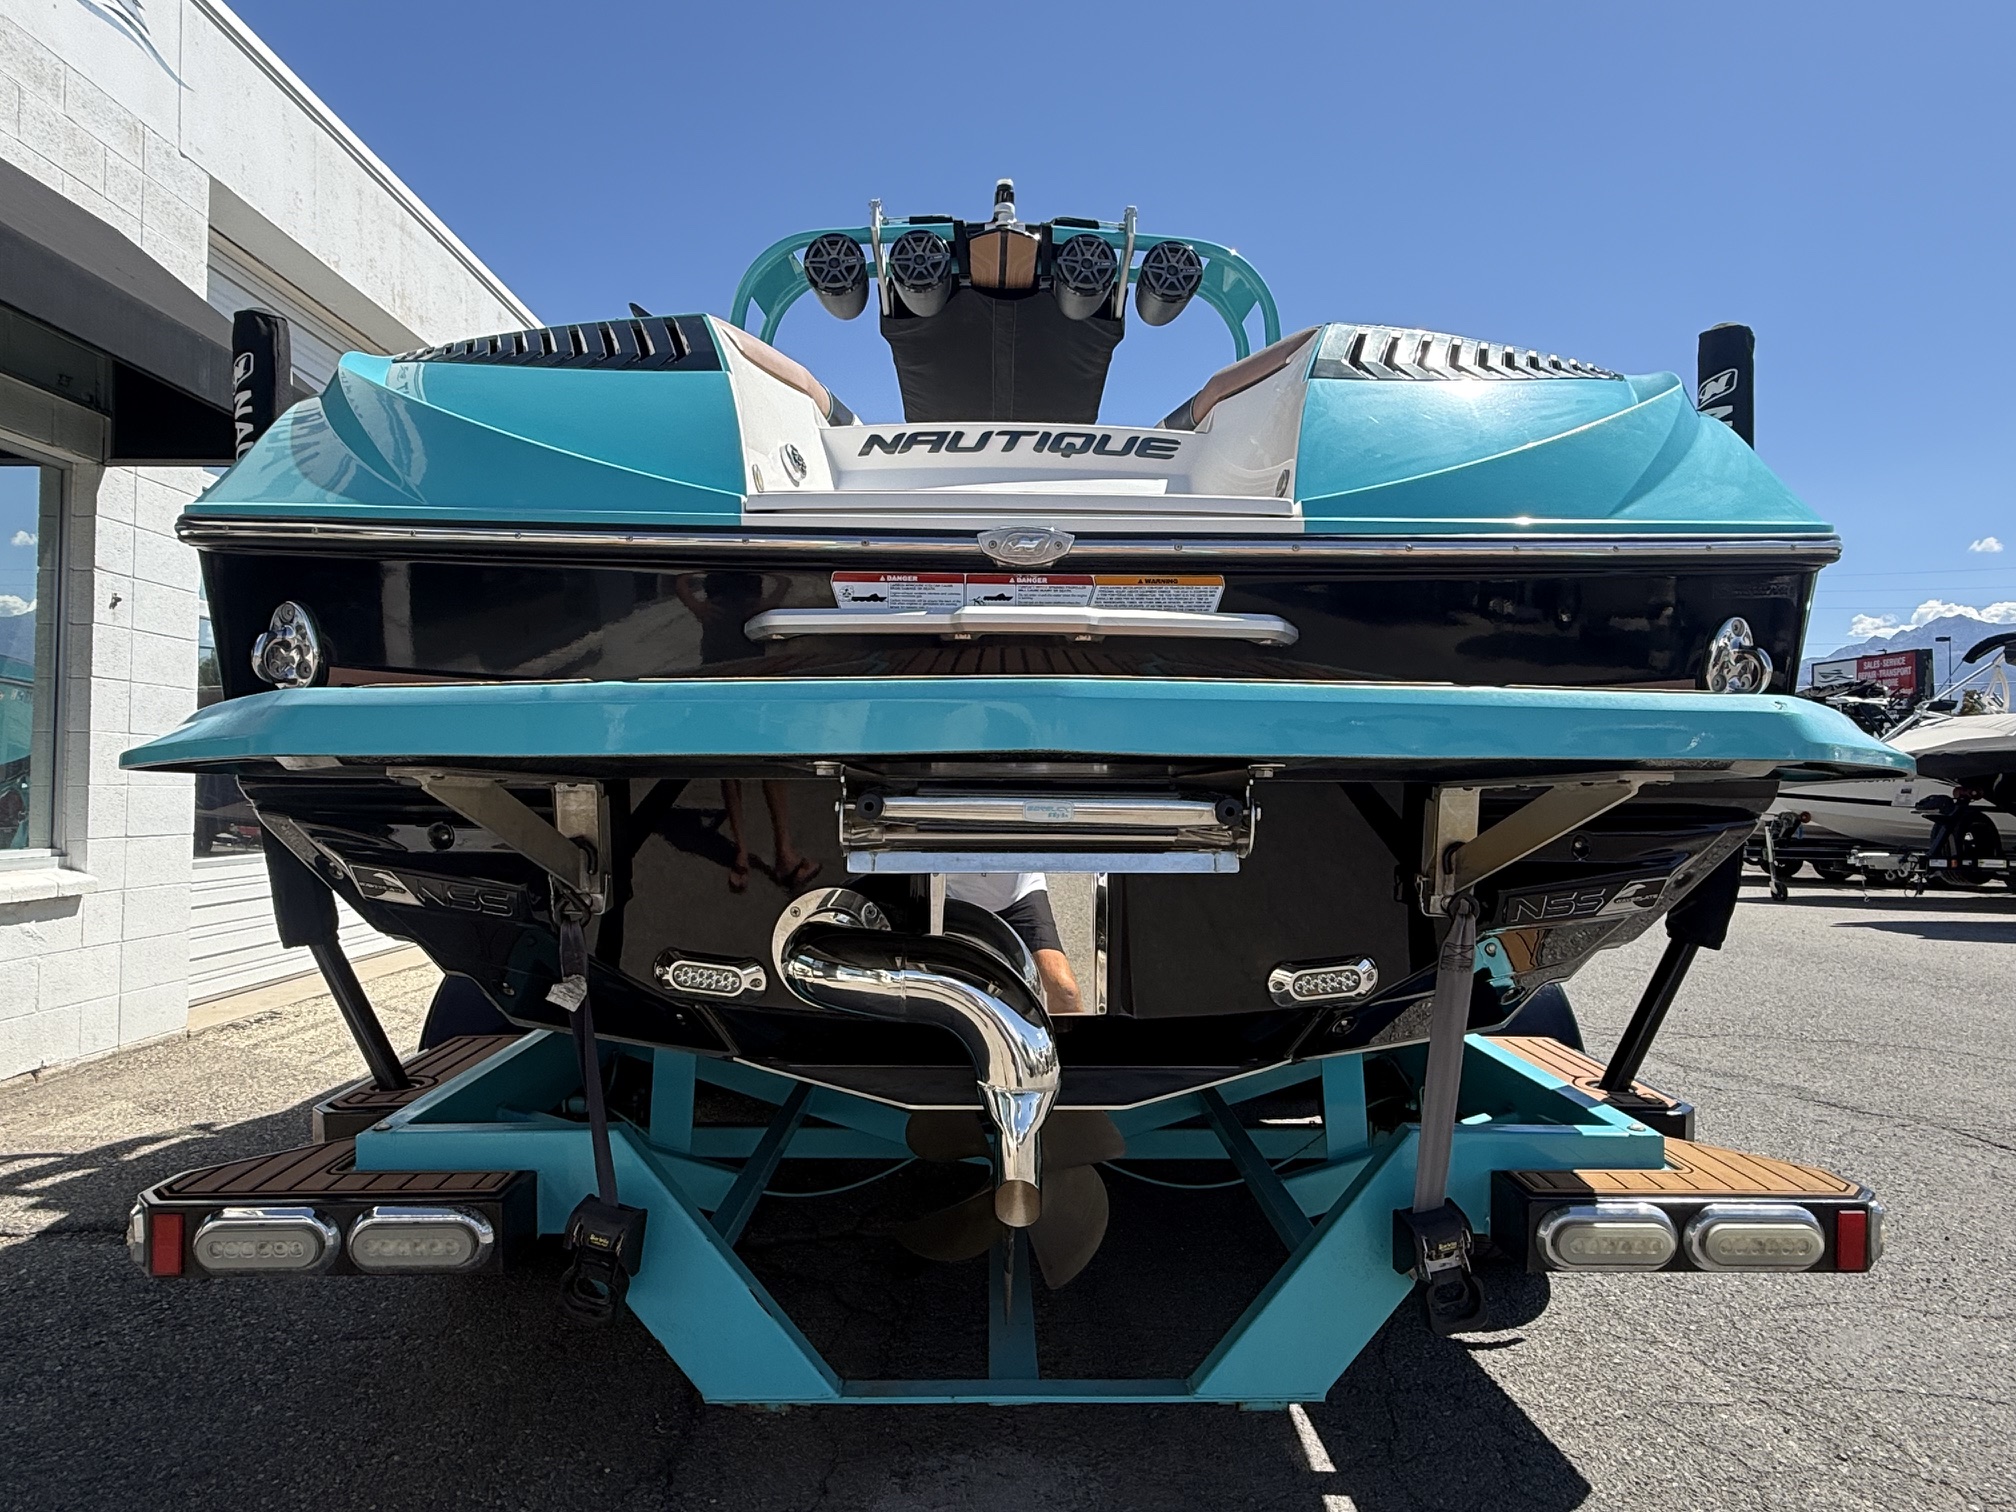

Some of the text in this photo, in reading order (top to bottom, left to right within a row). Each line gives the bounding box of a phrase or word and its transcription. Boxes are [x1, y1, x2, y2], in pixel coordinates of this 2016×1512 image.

[857, 430, 1181, 460] NAUTIQUE
[1864, 657, 1906, 670] SALES SERVICE
[1880, 666, 1912, 676] TRANSPORT
[415, 882, 513, 917] NSS
[1510, 888, 1606, 922] NSS
